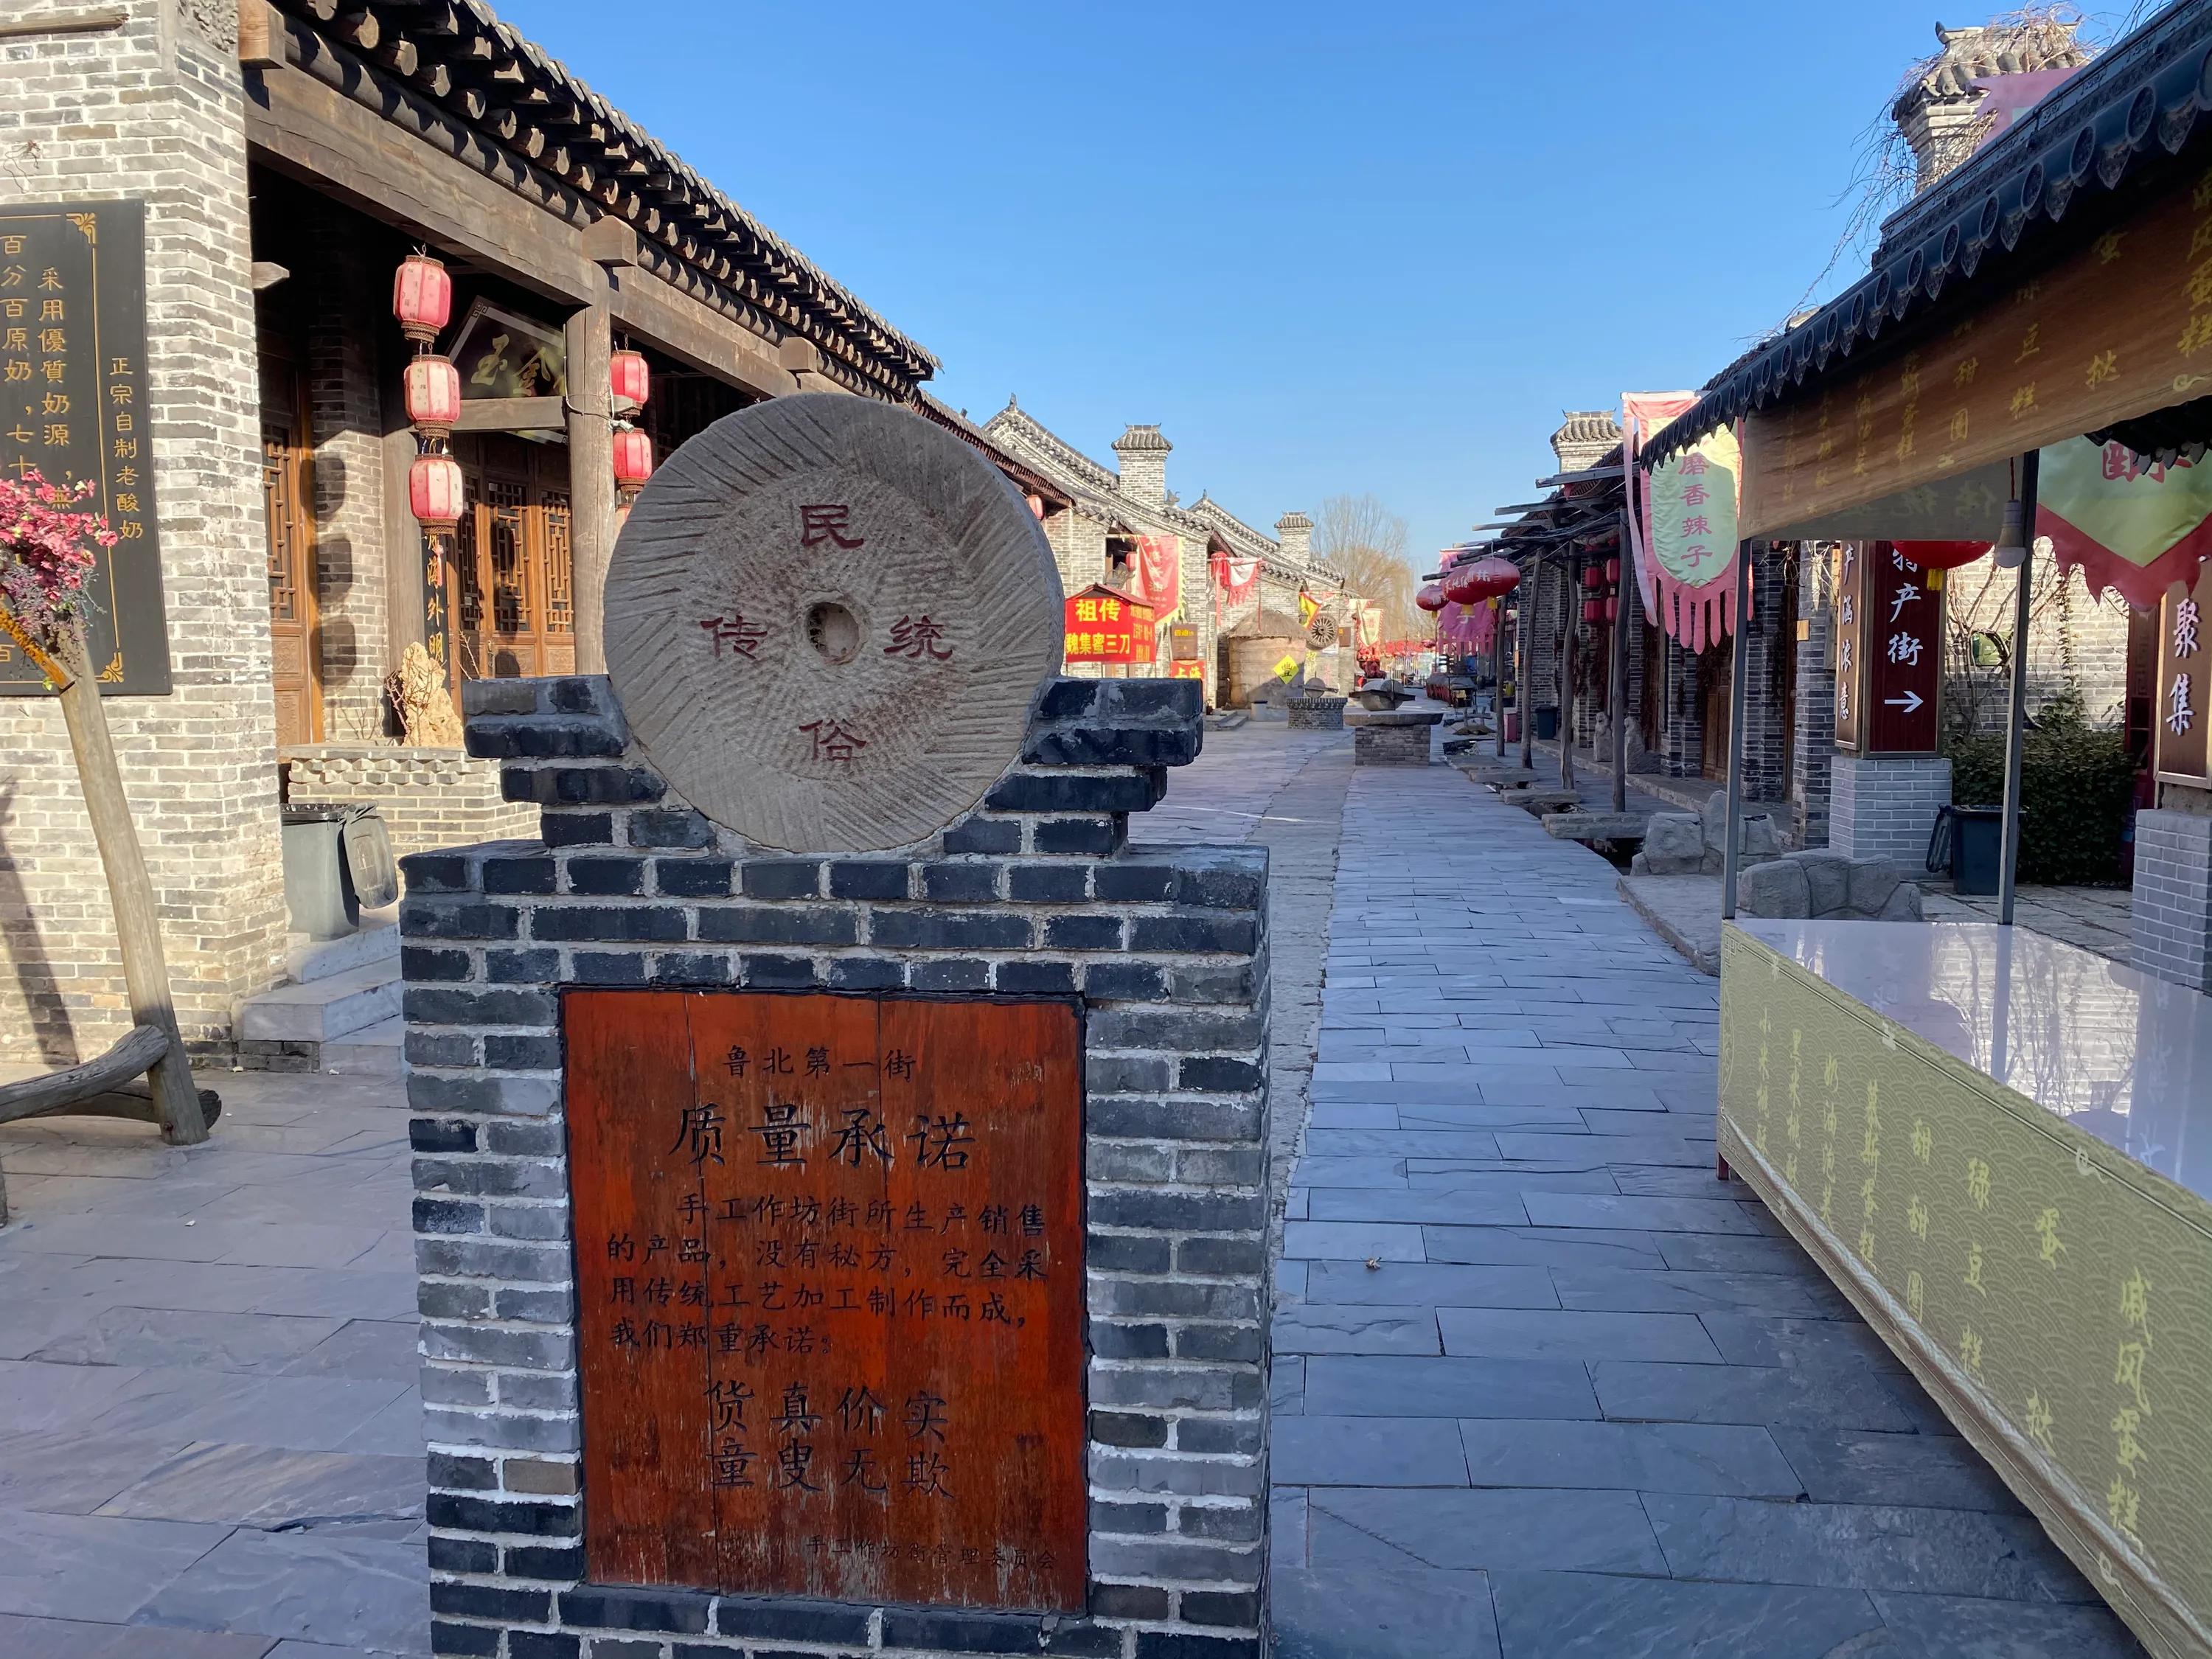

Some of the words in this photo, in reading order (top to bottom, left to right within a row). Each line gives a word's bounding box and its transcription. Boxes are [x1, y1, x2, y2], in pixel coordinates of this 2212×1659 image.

[0, 234, 37, 501] 百分百原奶，七十
[109, 357, 144, 540] 正宗自制老酸奶
[801, 505, 864, 549] 民
[1076, 599, 1121, 622] 祖传
[700, 615, 768, 659] 传
[883, 615, 953, 660] 统
[1066, 632, 1130, 655] 魏集蜜三刀
[799, 719, 866, 762] 俗
[721, 1045, 916, 1082] 鲁北第一街
[669, 1103, 976, 1171] 质量承诺
[676, 1194, 1046, 1238] 手工作坊街所生产销售
[705, 1380, 949, 1444] 货真价实
[706, 1437, 953, 1498] 童叟无欺
